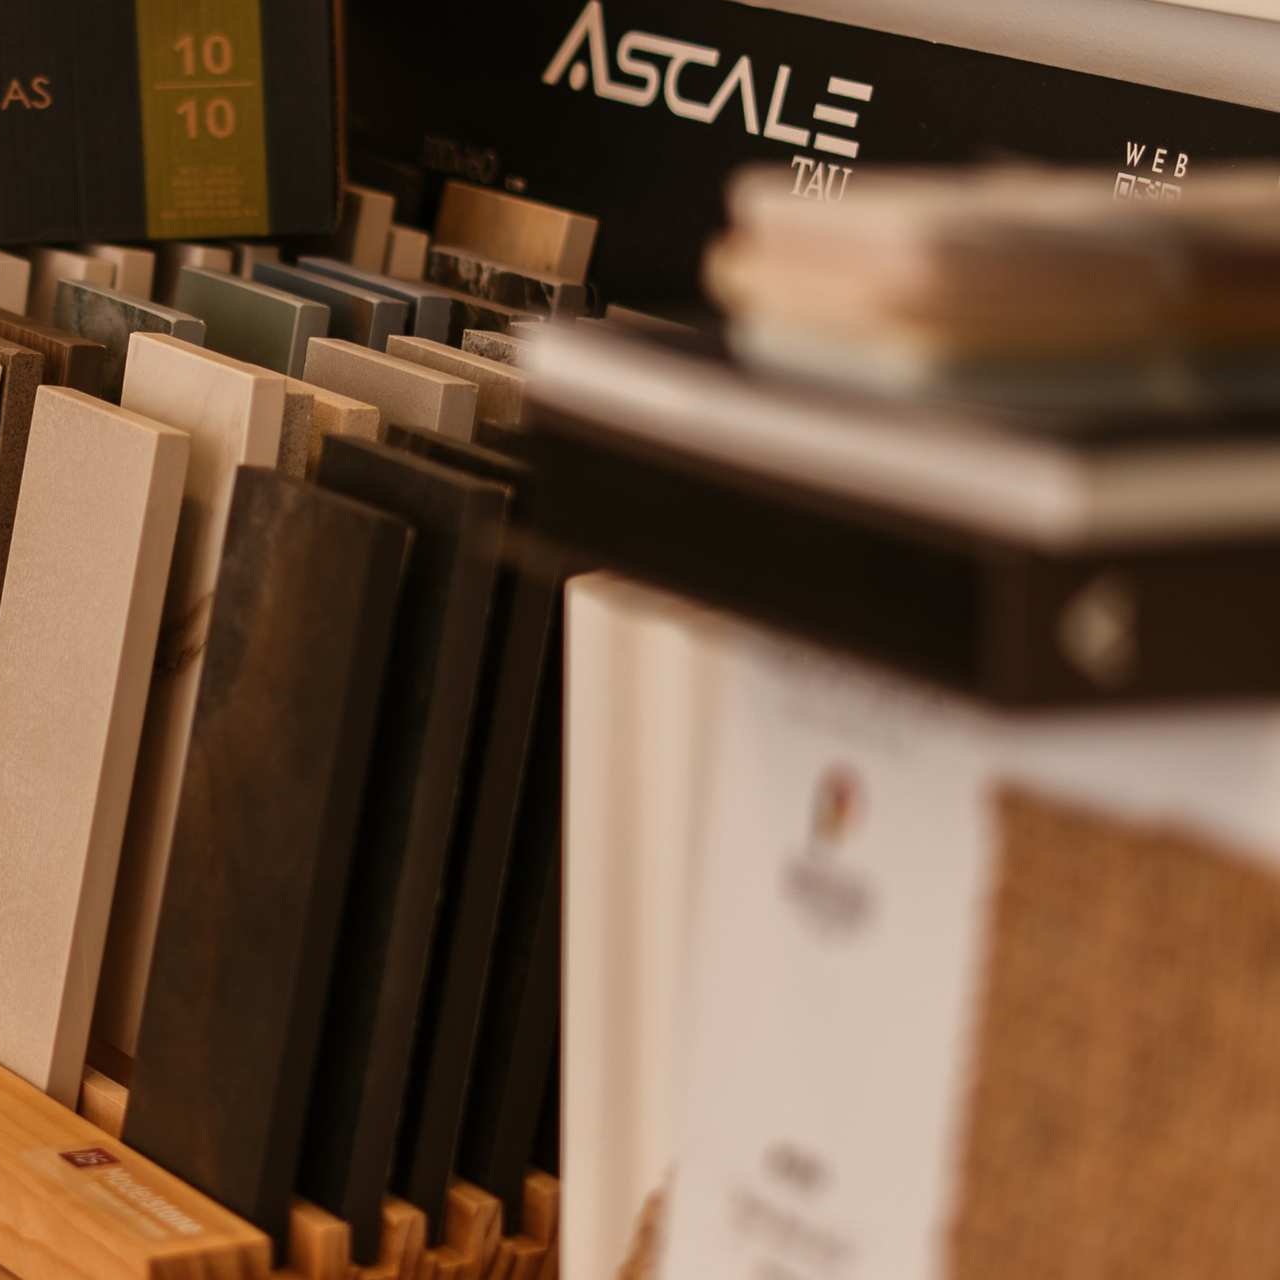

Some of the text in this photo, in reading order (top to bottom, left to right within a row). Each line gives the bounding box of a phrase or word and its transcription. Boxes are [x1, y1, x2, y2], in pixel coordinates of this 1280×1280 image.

[173, 33, 232, 76] 10
[176, 97, 235, 139] 10
[790, 155, 853, 204] TAU
[1126, 141, 1189, 178] WEB
